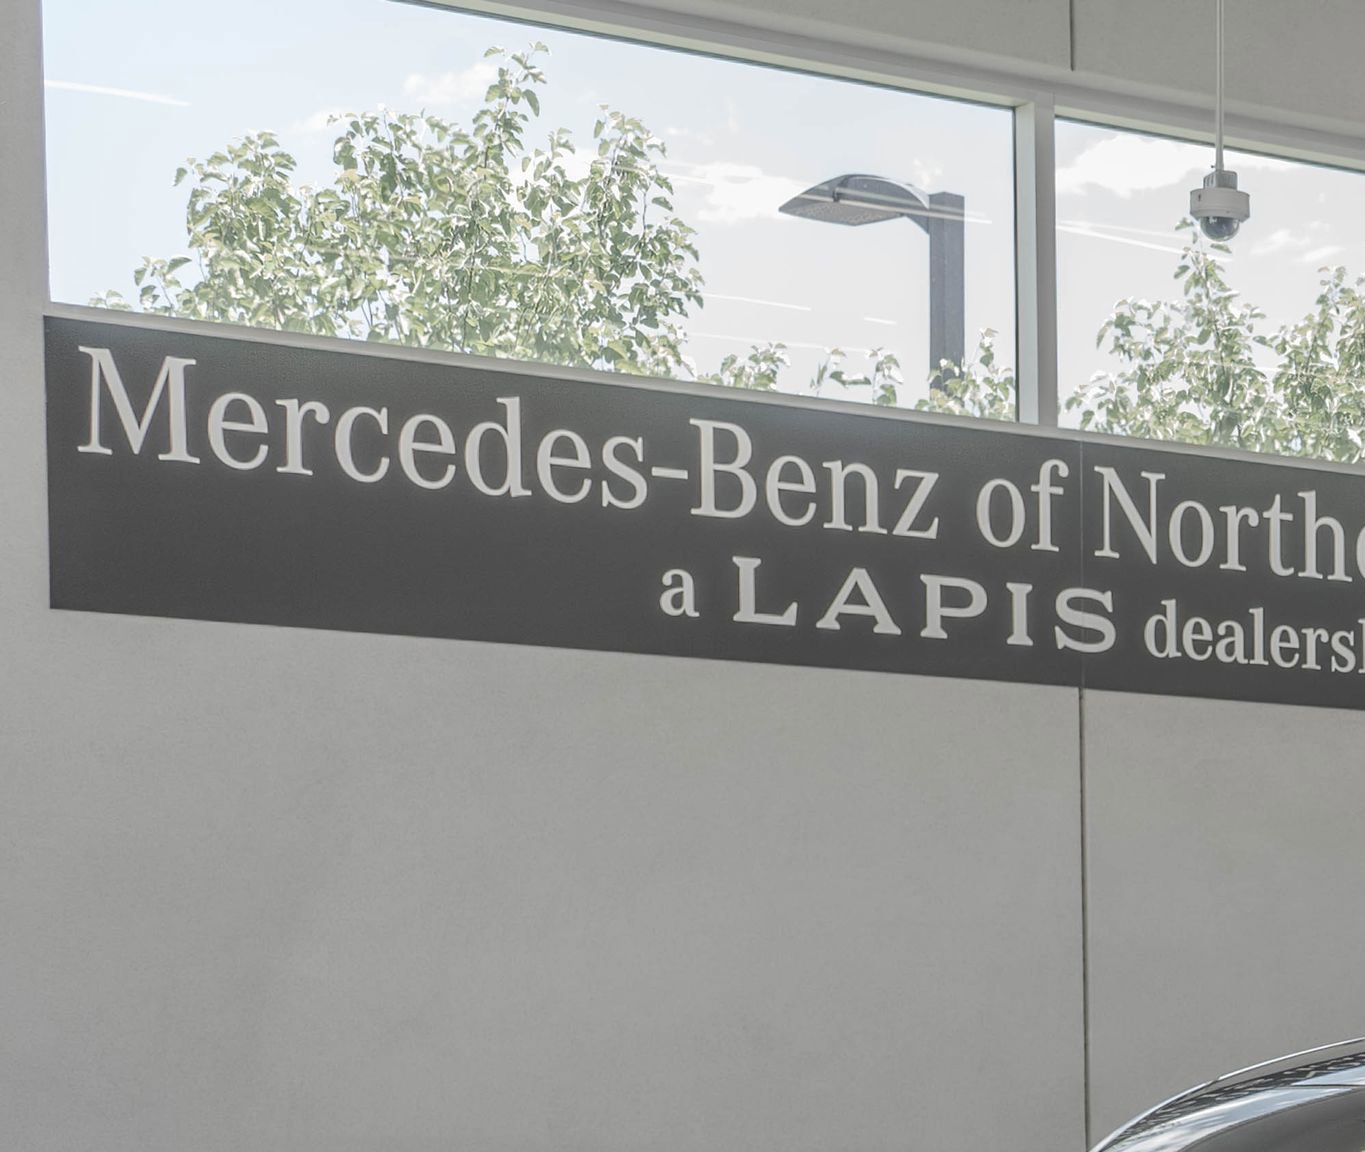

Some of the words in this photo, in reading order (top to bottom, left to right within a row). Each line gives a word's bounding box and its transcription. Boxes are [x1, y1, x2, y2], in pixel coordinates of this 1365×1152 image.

[77, 345, 940, 540] Mercedes-Benz
[975, 458, 1070, 553] of
[660, 568, 699, 618] a
[733, 556, 1116, 653] LAPIS
